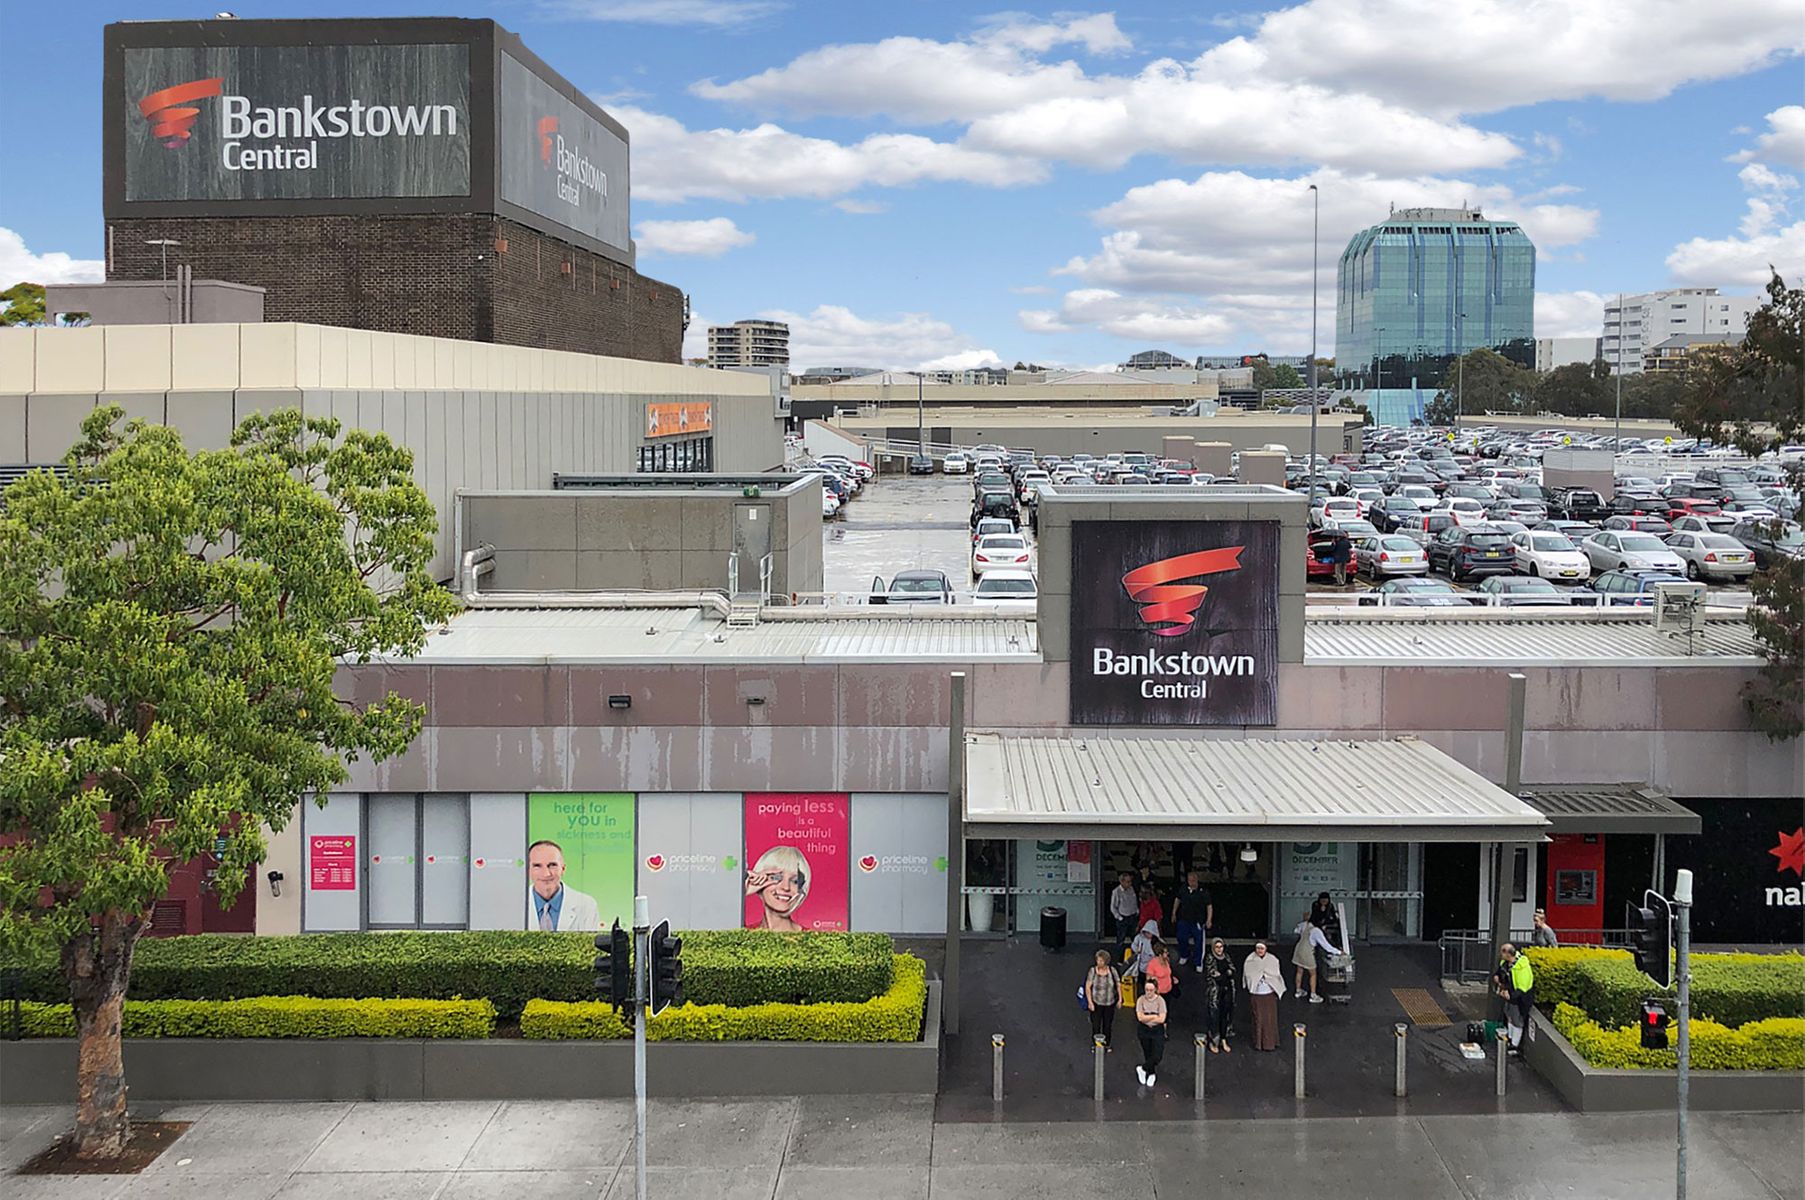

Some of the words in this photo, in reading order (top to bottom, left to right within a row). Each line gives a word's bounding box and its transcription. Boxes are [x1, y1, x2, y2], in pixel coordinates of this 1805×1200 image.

[222, 95, 457, 139] Bankstown
[222, 140, 318, 170] Central
[557, 134, 608, 197] Bankstown
[557, 174, 580, 208] Central
[1093, 647, 1255, 676] Bankstown
[1140, 679, 1208, 699] Central
[554, 801, 585, 814] here
[589, 801, 608, 814] for
[758, 801, 801, 816] paying
[804, 799, 835, 813] less
[567, 815, 601, 829] you
[605, 815, 617, 826] in
[798, 816, 805, 825] is
[557, 829, 607, 839] sickness
[609, 829, 632, 839] and
[777, 827, 831, 839] beautiful
[807, 842, 836, 855] thing
[881, 854, 928, 866] priceline
[1036, 853, 1068, 861] DECEM
[1292, 856, 1338, 864] DECEMBER
